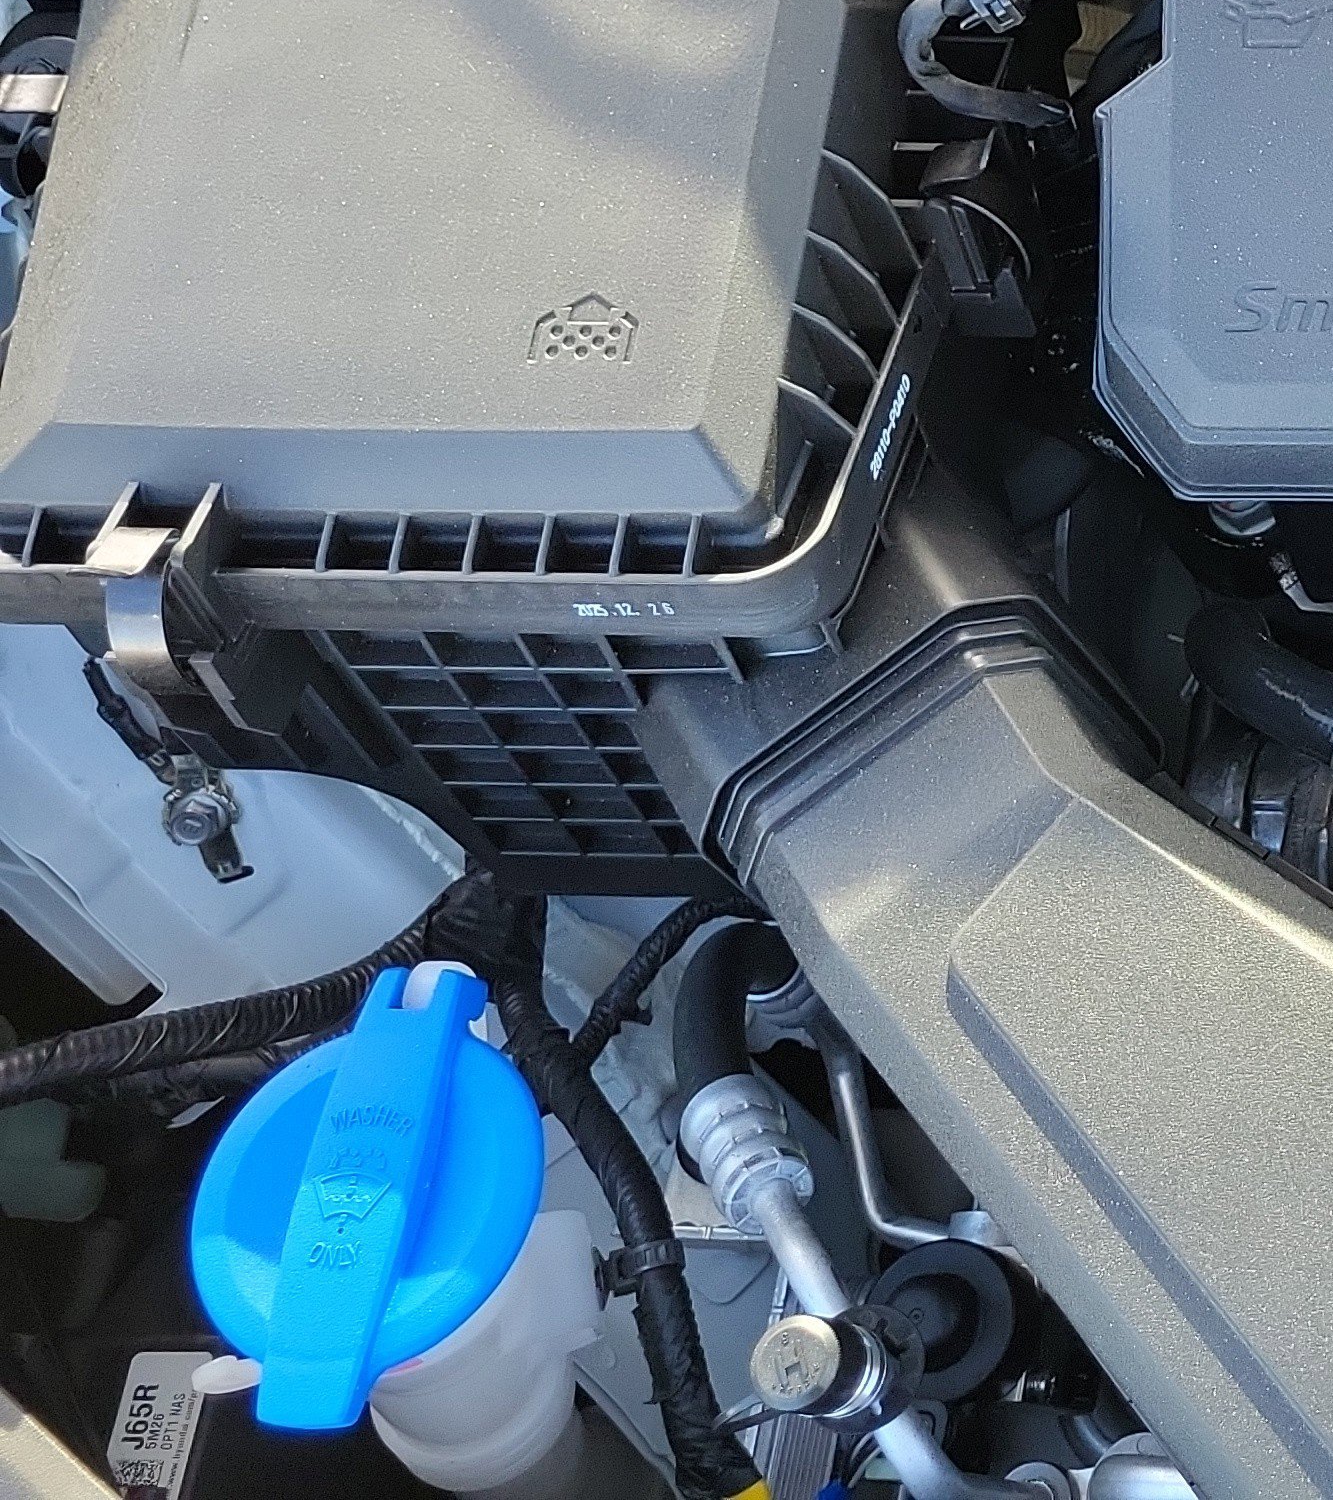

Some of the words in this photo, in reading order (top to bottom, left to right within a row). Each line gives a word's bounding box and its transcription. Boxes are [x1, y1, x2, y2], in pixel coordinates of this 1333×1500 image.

[330, 1104, 415, 1139] WASHER
[308, 1240, 361, 1268] ONLY
[120, 1383, 159, 1452] J65R
[169, 1392, 187, 1417] NAS
[145, 1412, 165, 1450] 5M26
